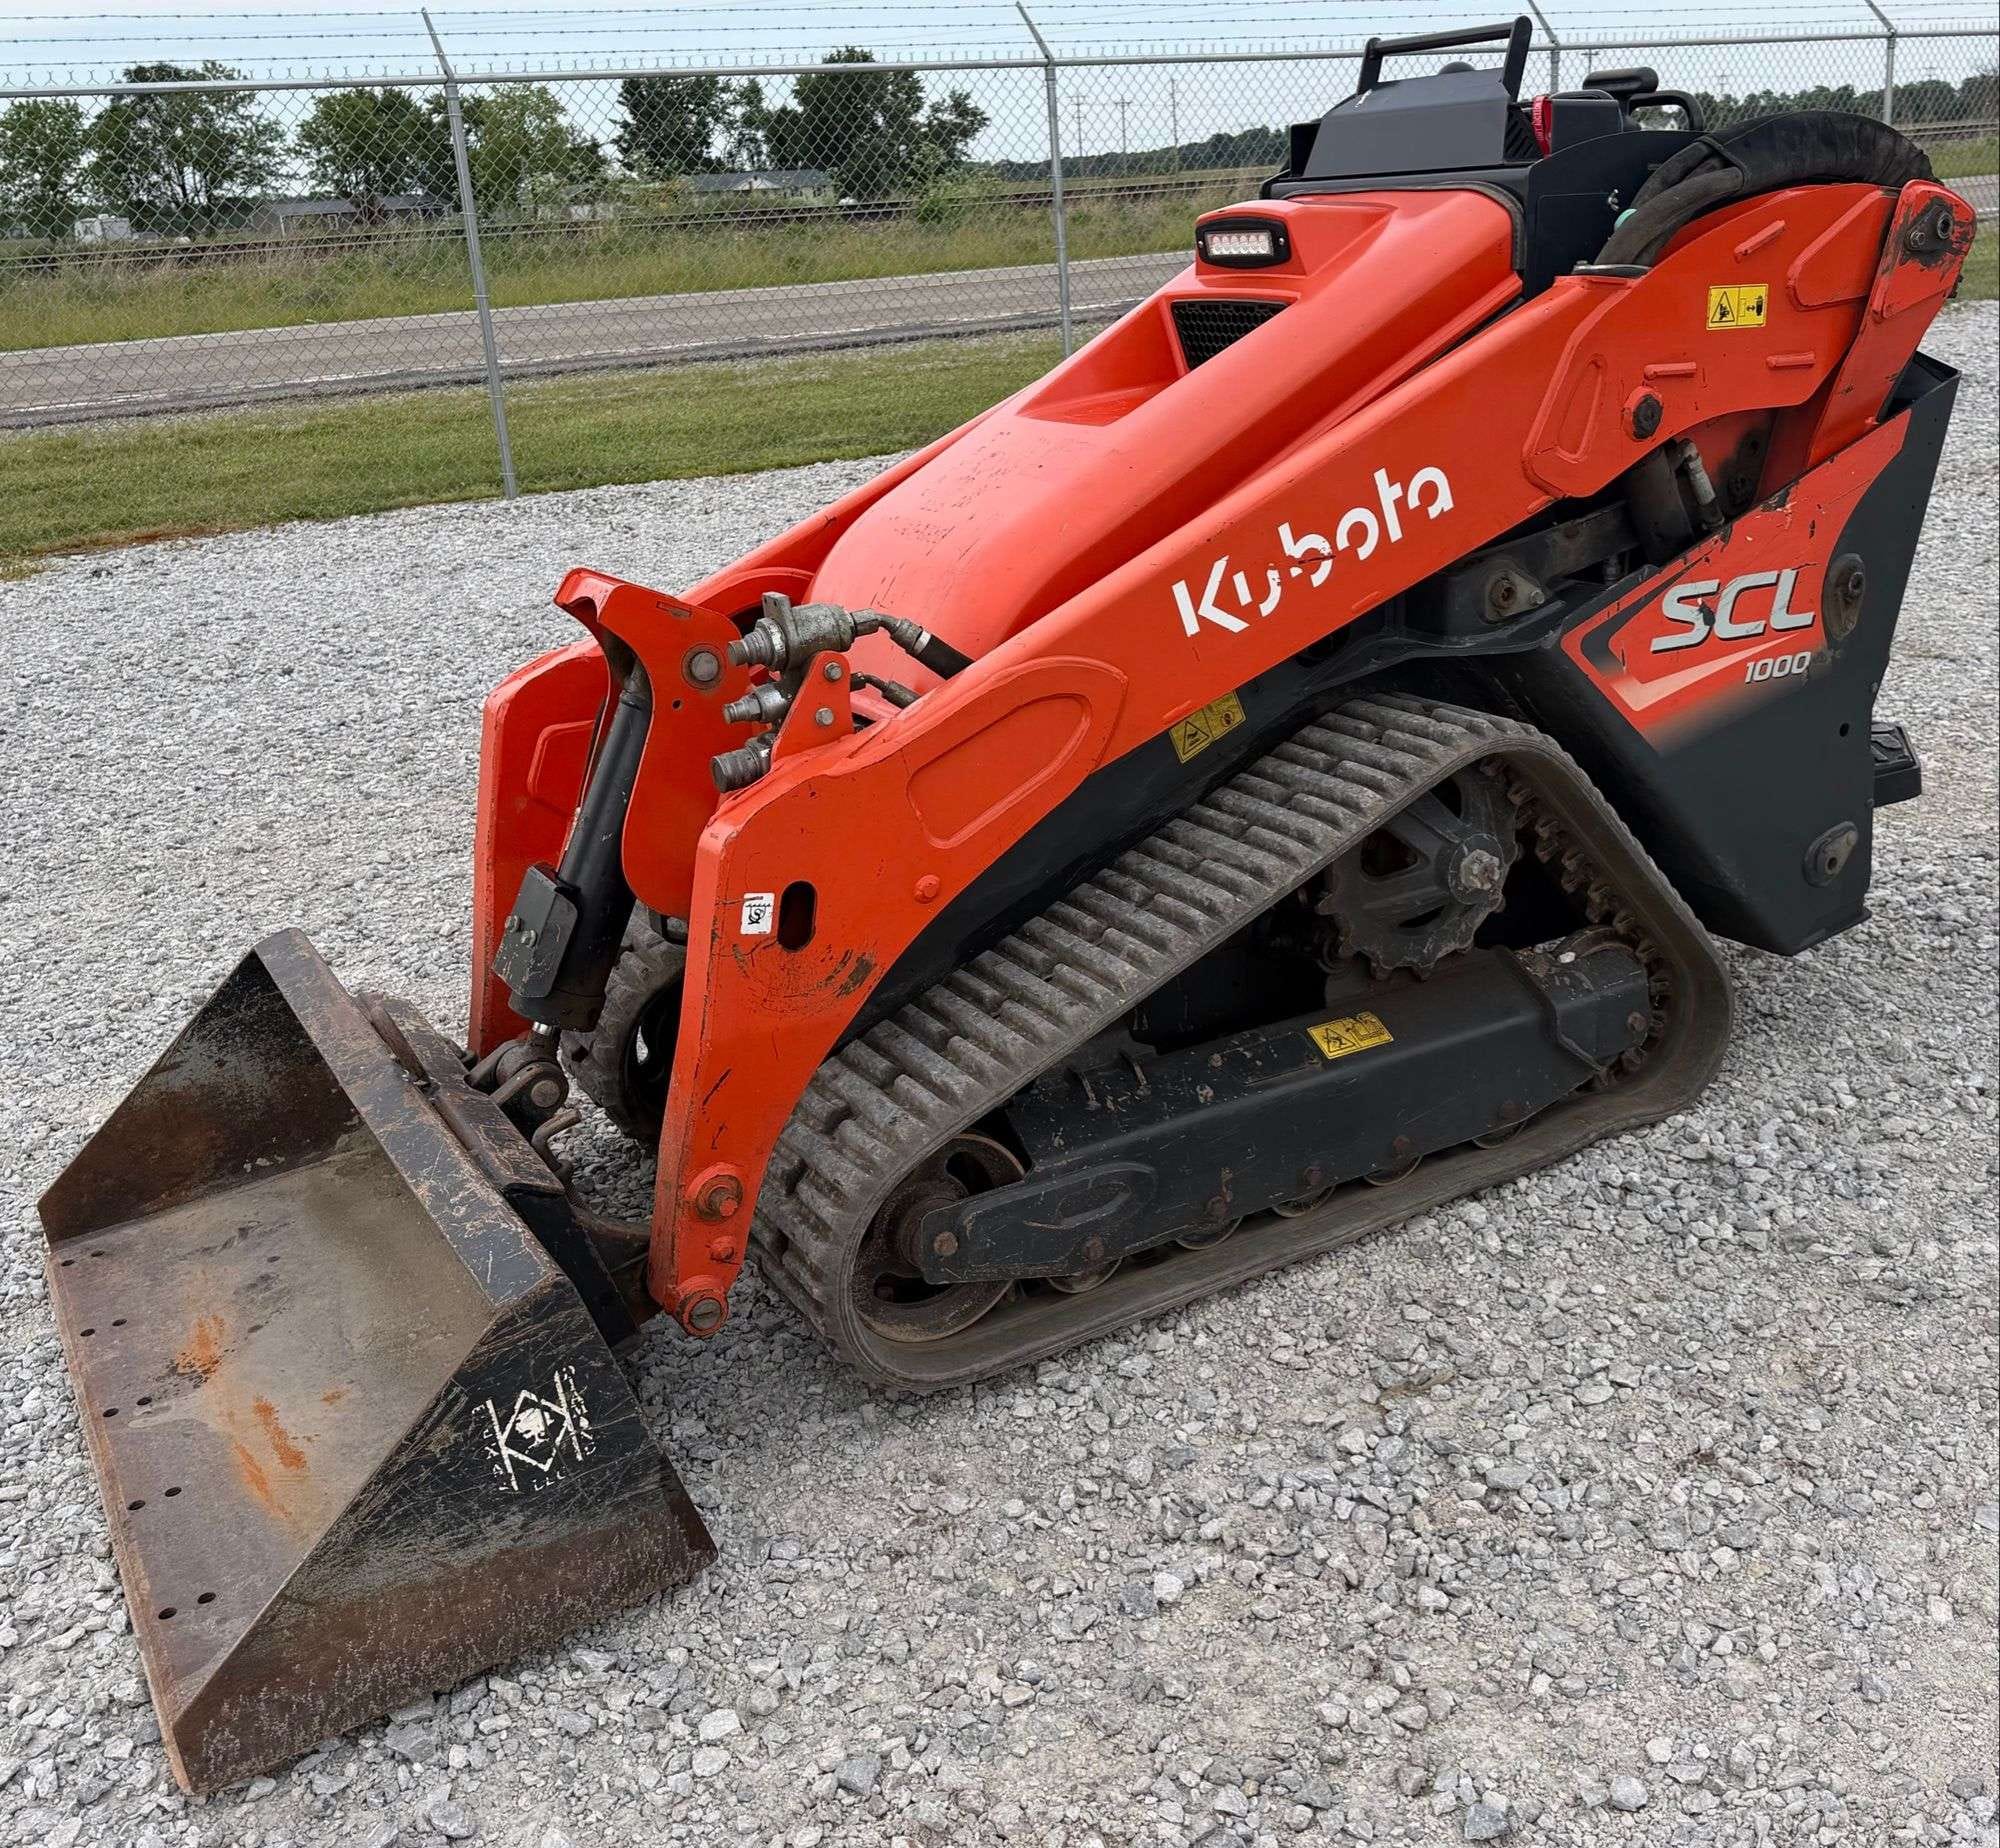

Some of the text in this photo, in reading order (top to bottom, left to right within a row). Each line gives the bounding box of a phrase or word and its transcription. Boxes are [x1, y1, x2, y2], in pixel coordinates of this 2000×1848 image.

[1172, 466, 1455, 638] Kubota
[1650, 568, 1816, 652] SCL
[1744, 651, 1812, 684] 1000
